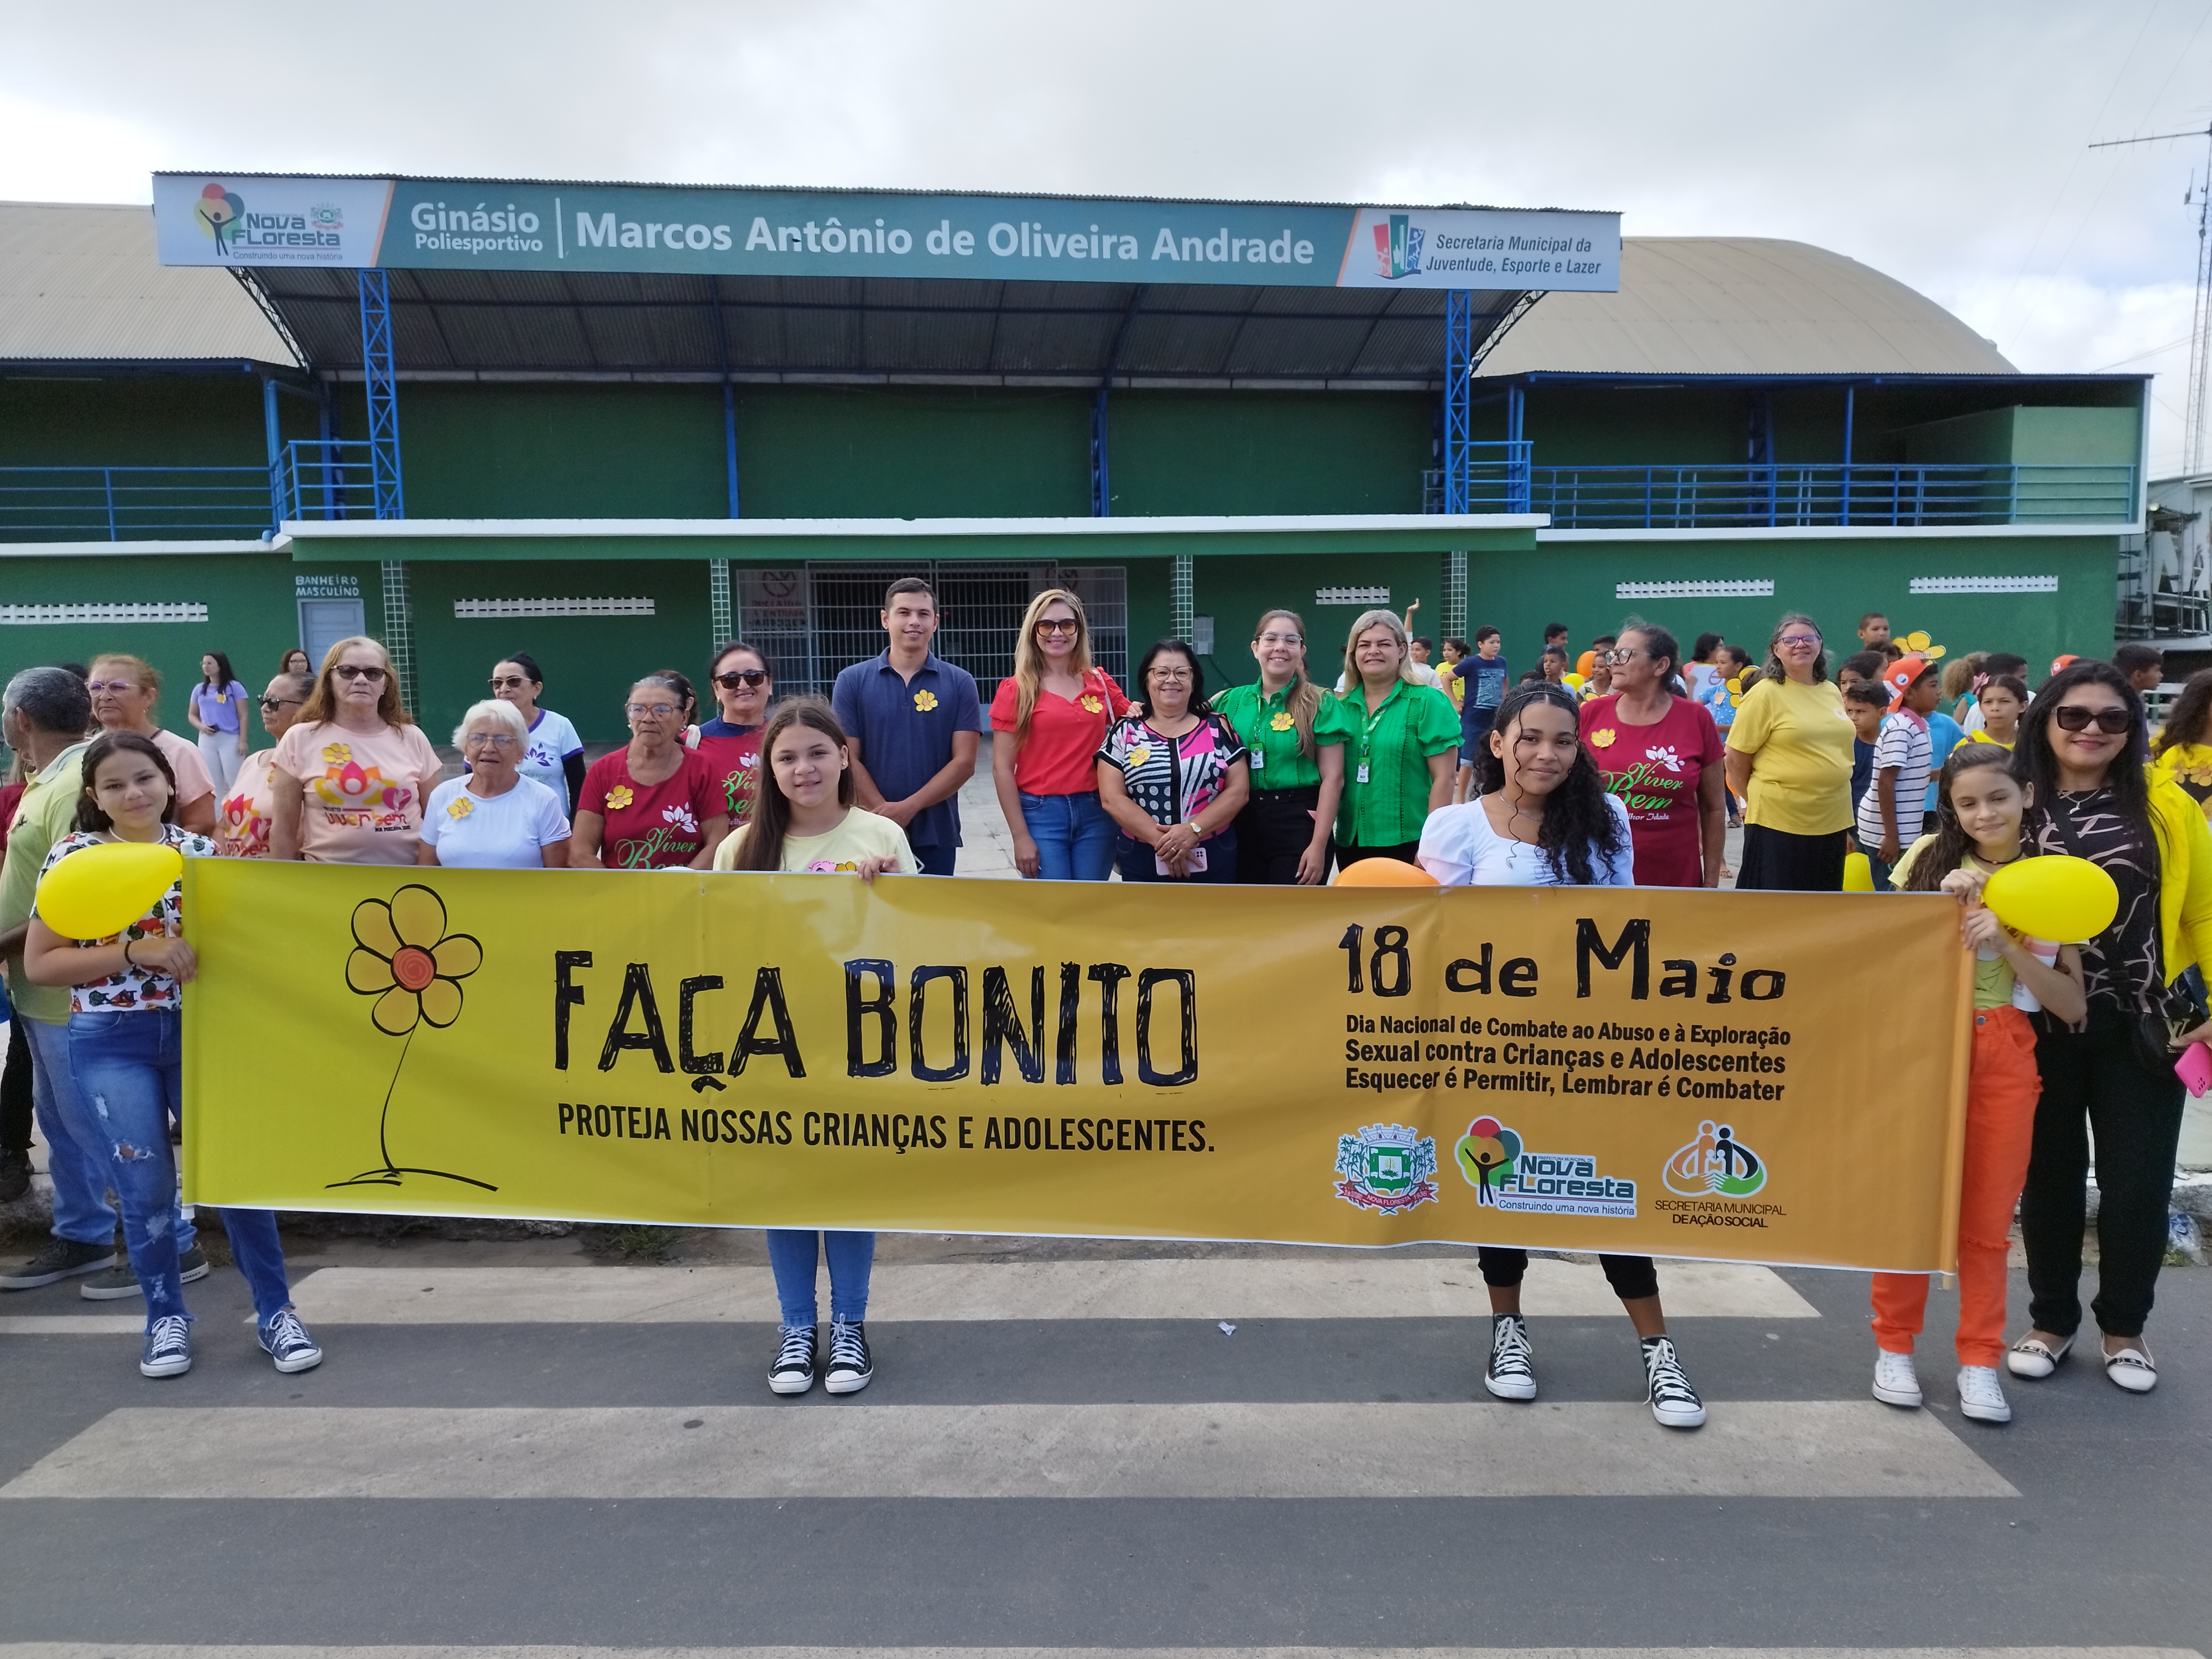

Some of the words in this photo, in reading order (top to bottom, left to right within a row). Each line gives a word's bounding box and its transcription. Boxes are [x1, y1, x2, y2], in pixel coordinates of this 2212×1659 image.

[247, 213, 306, 229] Nova
[411, 202, 539, 233] Ginásio
[415, 233, 543, 254] Poliesportivo
[576, 211, 733, 251] Marcos
[745, 217, 912, 254] Antônio
[926, 220, 975, 255] de
[987, 221, 1139, 260] Oliveira
[1151, 227, 1314, 264] Andrade
[1437, 234, 1504, 250] Secretaria
[1509, 236, 1573, 254] Municipal
[1576, 238, 1592, 252] da
[1427, 256, 1496, 274] Juventude,
[1502, 258, 1550, 275] Esporte
[1554, 263, 1562, 273] e
[1567, 259, 1601, 274] Lazer
[1338, 923, 1412, 997] 18
[1445, 942, 1538, 997] de
[1575, 918, 1787, 1004] Maio
[554, 951, 806, 1093] FAÇA
[844, 959, 1198, 1087] BONITO
[1346, 1014, 1375, 1033] Dia
[1380, 1015, 1455, 1034] Nacional
[1460, 1016, 1482, 1035] de
[1487, 1018, 1567, 1038] Combate
[1572, 1025, 1594, 1039] ao
[1598, 1022, 1654, 1041] Abuso
[1659, 1029, 1670, 1042] e
[1674, 1022, 1685, 1042] à
[1691, 1025, 1791, 1049] Exploração
[1345, 1039, 1420, 1062] Sexual
[1426, 1041, 1496, 1063] contra
[1503, 1042, 1605, 1072] Crianças
[1610, 1051, 1624, 1068] e
[1629, 1047, 1786, 1073] Adolescentes
[1345, 1067, 1440, 1093] Esquecer
[1444, 1066, 1457, 1088] é
[1464, 1068, 1556, 1097] Permitir,
[1563, 1073, 1653, 1095] Lembrar
[1657, 1074, 1671, 1097] é
[1676, 1077, 1785, 1100] Combater
[558, 1103, 671, 1140] PROTEJA
[681, 1109, 792, 1145] NOSSAS
[804, 1112, 947, 1154] CRIANÇAS
[958, 1116, 974, 1149] E
[984, 1117, 1215, 1152] ADOLESCENTES.
[1521, 1155, 1594, 1177] Nova
[1367, 1194, 1383, 1204] NOVA
[1383, 1195, 1411, 1206] FLORESTA
[1413, 1191, 1427, 1200] 1936
[1499, 1199, 1553, 1211] Construindo
[1602, 1205, 1635, 1215] história
[1655, 1200, 1723, 1212] SECRETARIA
[1724, 1203, 1787, 1215] MUNICIPAL
[1724, 1217, 1768, 1228] SOCIAL
